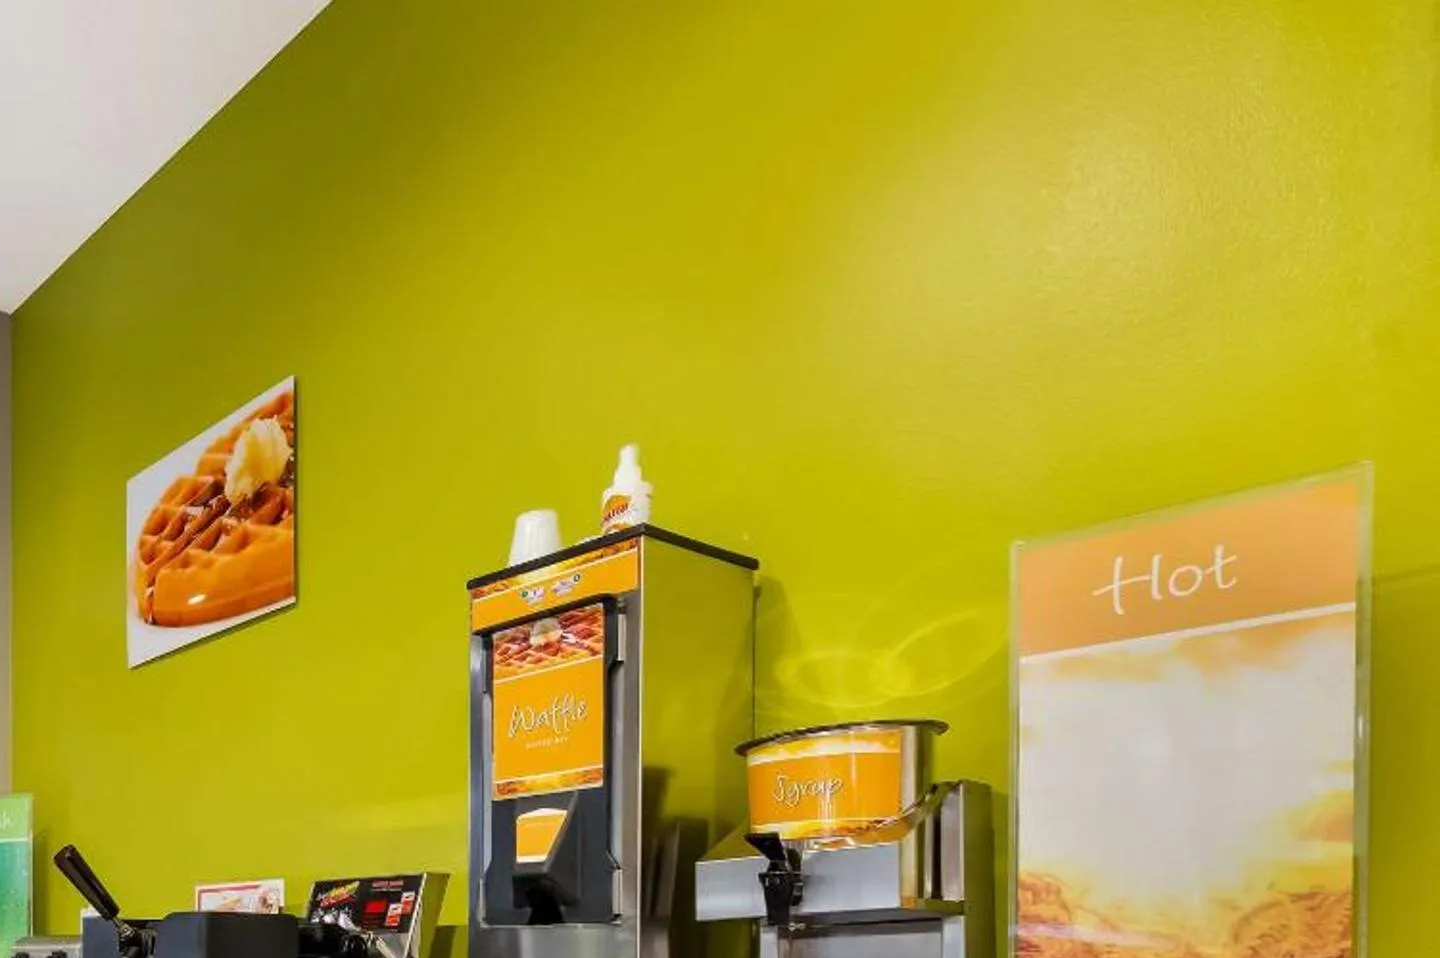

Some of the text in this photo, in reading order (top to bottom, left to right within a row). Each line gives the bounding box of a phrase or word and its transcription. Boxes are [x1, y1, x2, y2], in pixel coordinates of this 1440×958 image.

[1092, 545, 1238, 615] Hot
[508, 693, 588, 738] Waffle
[772, 775, 843, 809] Syrup
